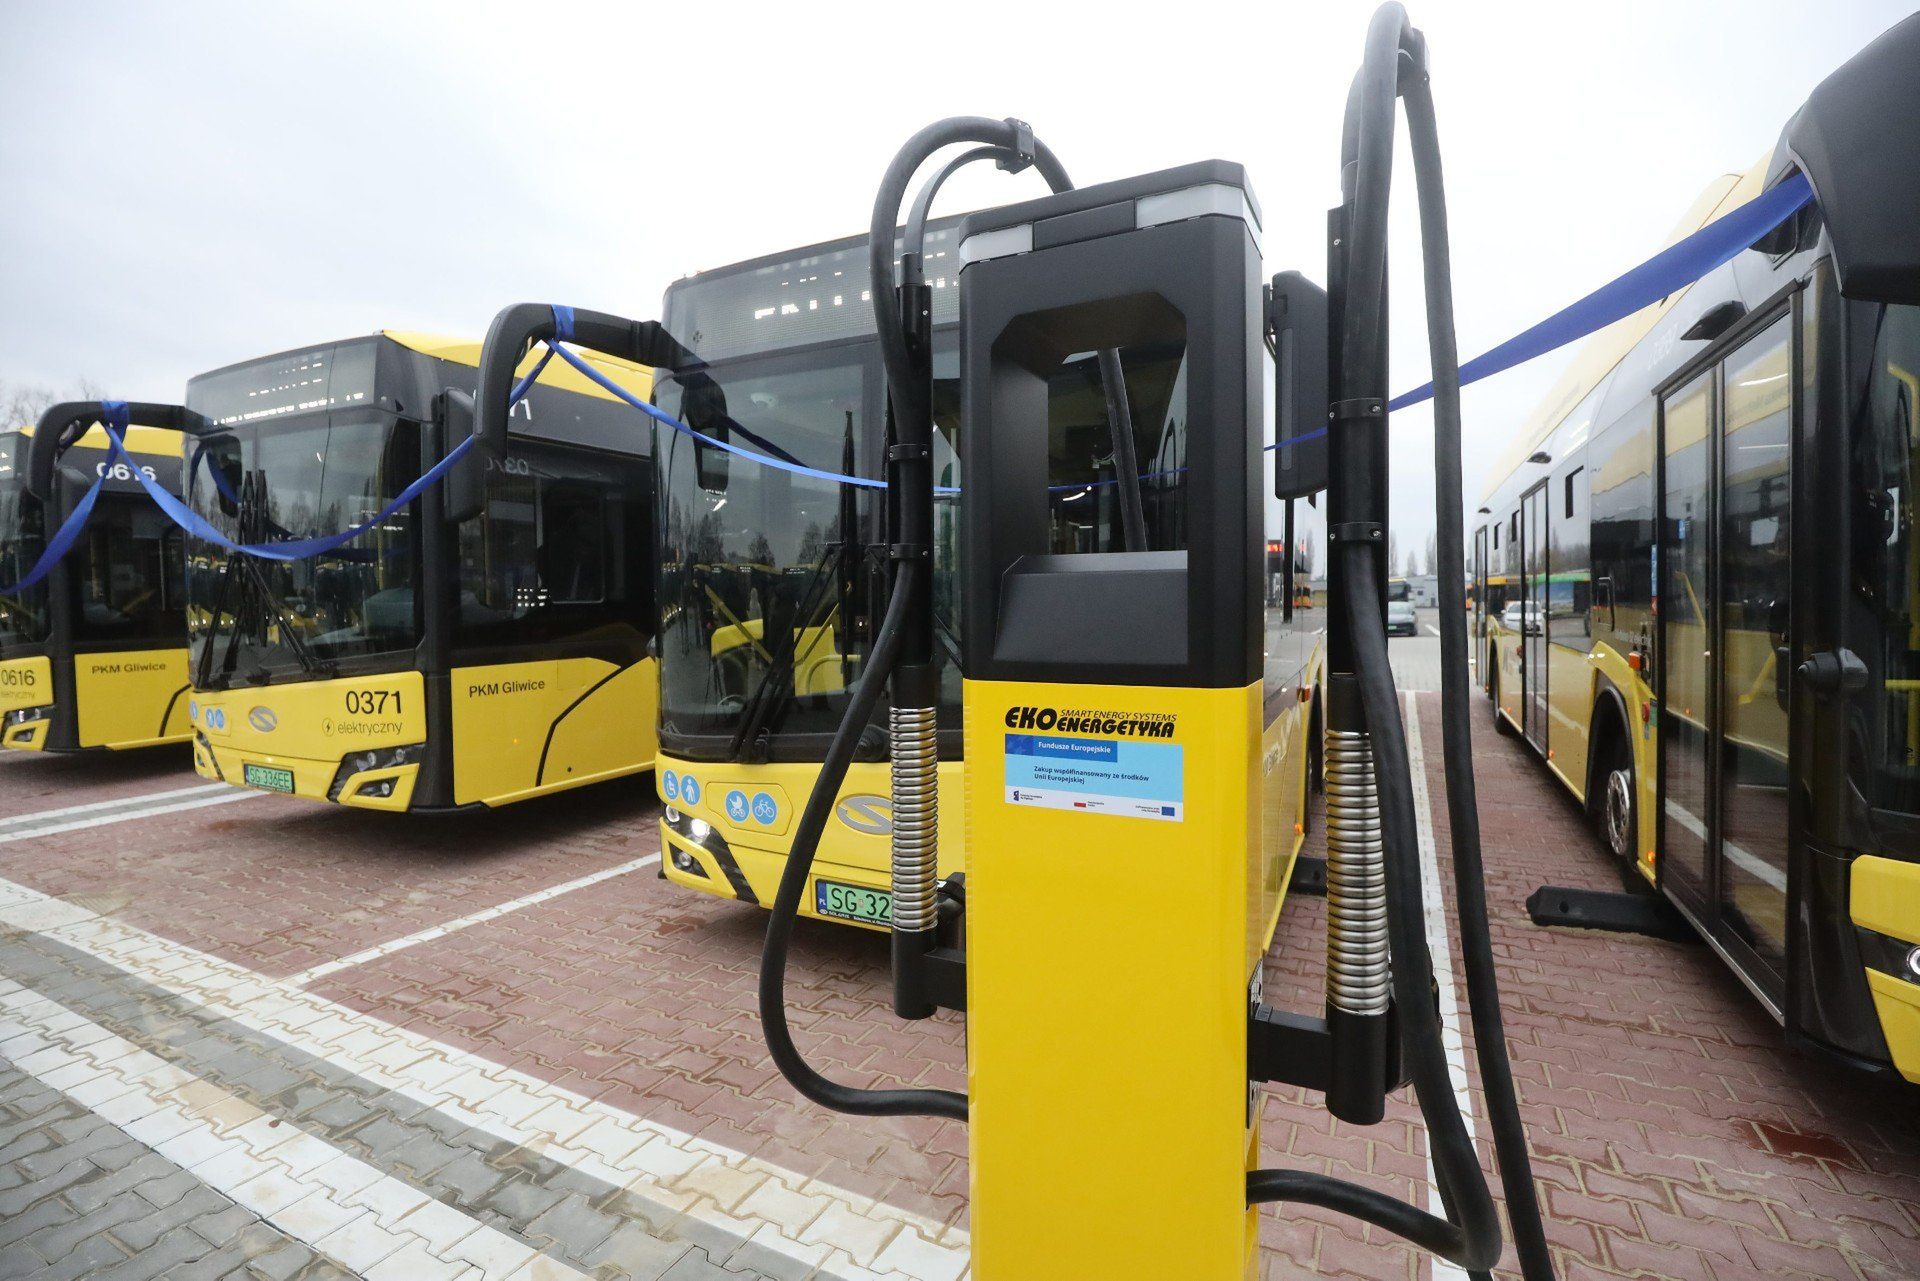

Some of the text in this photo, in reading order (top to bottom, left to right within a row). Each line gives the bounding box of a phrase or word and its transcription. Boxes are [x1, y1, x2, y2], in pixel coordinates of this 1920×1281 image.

[91, 662, 166, 675] PKM Gliwice
[1, 669, 35, 686] 0616
[469, 679, 545, 698] PKM Gliwice
[345, 690, 402, 714] 0371
[1060, 709, 1177, 722] SMART ENERGY SYSTEMS
[337, 721, 403, 736] elektryczny
[1038, 741, 1111, 754] Fundusze Europejskie
[1033, 765, 1053, 774] Zakup
[1054, 767, 1111, 779] współfinansowany
[1121, 773, 1150, 782] środków
[1048, 775, 1085, 784] Europejskiej
[831, 888, 857, 912] SG
